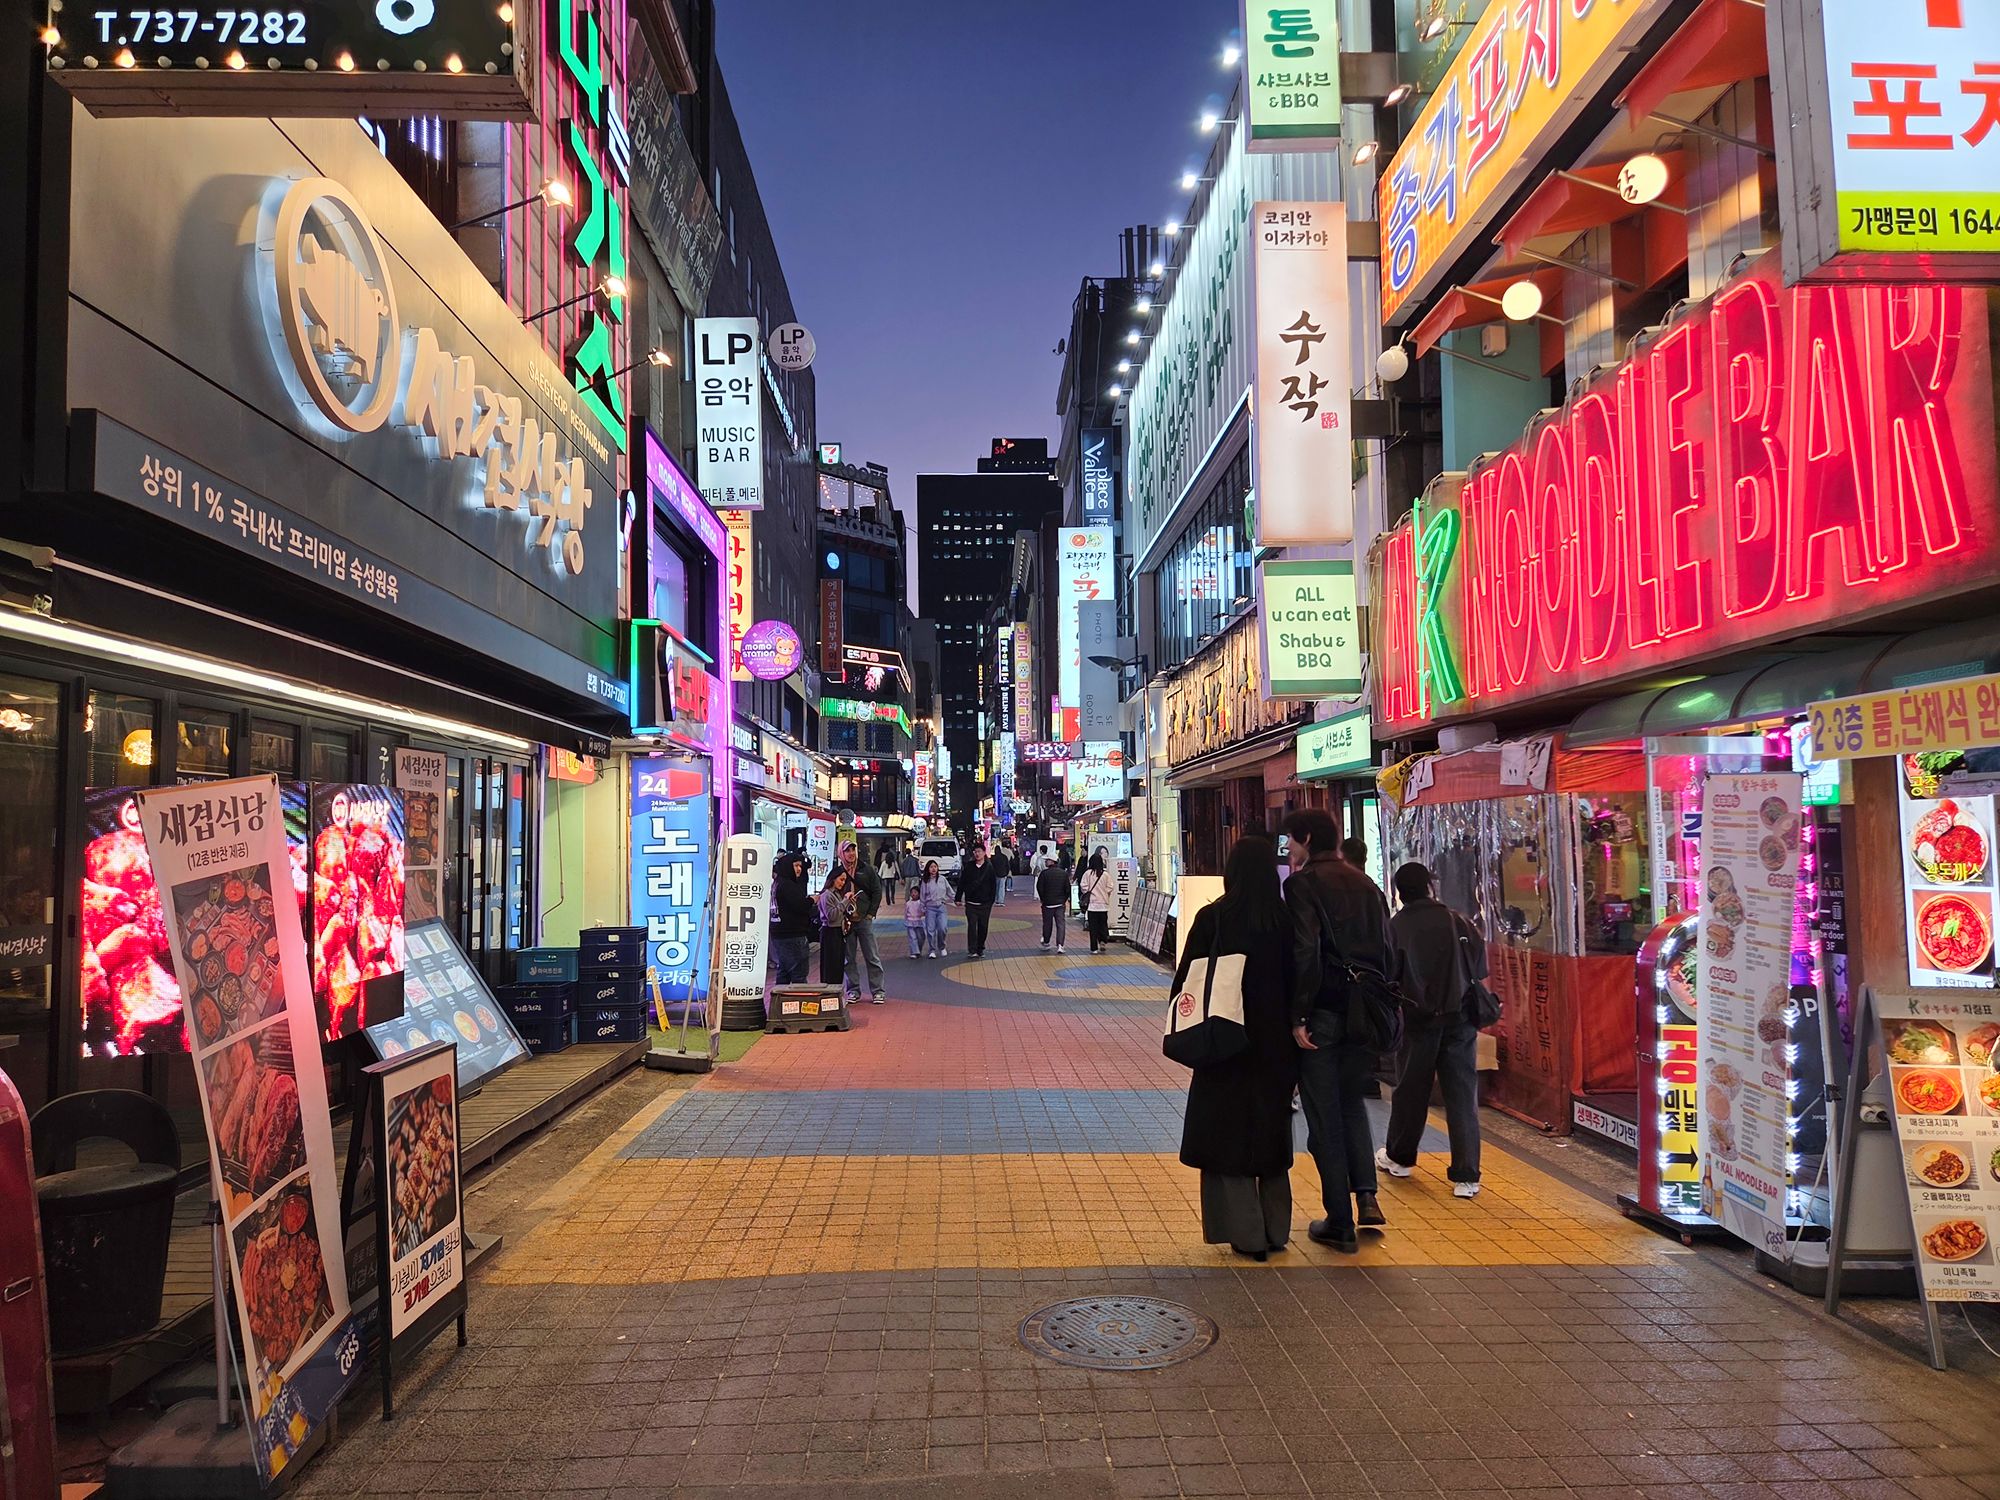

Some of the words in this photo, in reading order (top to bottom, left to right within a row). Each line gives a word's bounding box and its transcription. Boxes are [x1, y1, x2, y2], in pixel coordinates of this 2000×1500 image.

[95, 12, 307, 44] T.737-7282
[1257, 72, 1331, 88] 샤브샤브
[1263, 210, 1312, 227] 코리안
[1851, 207, 1938, 236] 가맹문의
[1264, 230, 1329, 247] 이자카야
[780, 329, 805, 345] LP
[702, 333, 753, 366] LP
[781, 354, 803, 363] BAR
[1278, 310, 1330, 424] 수작
[701, 376, 754, 407] 음악
[528, 360, 568, 414] SAEGYEOP
[570, 408, 610, 466] RESTAURANT
[702, 426, 756, 443] MUSIC
[709, 447, 750, 463] BAR
[1712, 280, 1961, 618] BAR
[139, 454, 182, 509] 상위
[191, 481, 224, 523] 1%
[230, 498, 283, 553] 국내산
[287, 527, 346, 581] 프리미엄
[1461, 322, 1703, 700] NOODLE
[1295, 586, 1325, 602] ALL
[1271, 610, 1282, 622] u
[1285, 609, 1318, 622] can
[1321, 606, 1351, 622] eat
[1094, 612, 1102, 646] PHOTO
[1279, 633, 1333, 648] Shabu
[1296, 653, 1332, 668] BBQ
[640, 775, 669, 796] 24
[158, 791, 268, 847] 새겹식당
[209, 845, 229, 864] 반찬
[228, 840, 250, 861] 제공)
[727, 848, 759, 874] LP
[642, 816, 699, 966] 노래방
[1116, 869, 1131, 925] 포토부스
[726, 905, 756, 932] LP
[598, 949, 617, 962] Cass
[596, 986, 616, 1000] Cass
[727, 986, 753, 997] Music
[597, 1024, 616, 1037] Cass
[1735, 1168, 1763, 1192] NOODLE
[1762, 1181, 1779, 1199] BAR
